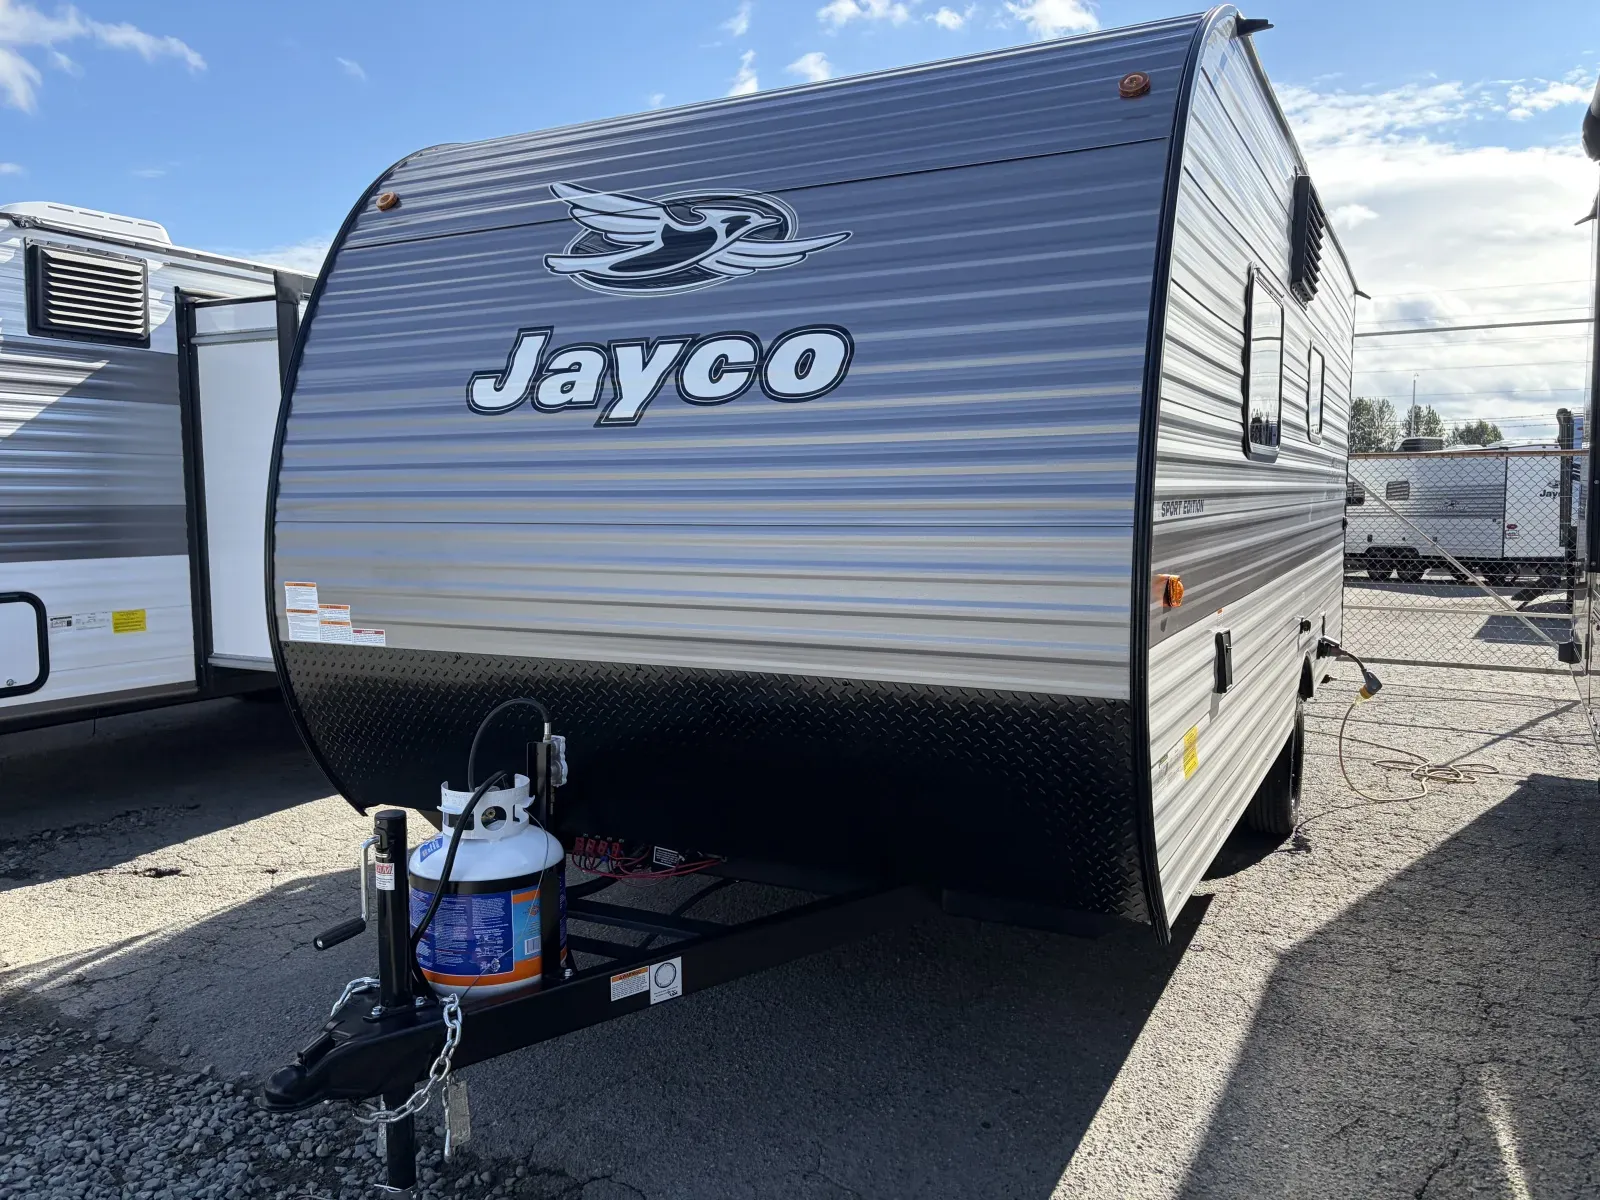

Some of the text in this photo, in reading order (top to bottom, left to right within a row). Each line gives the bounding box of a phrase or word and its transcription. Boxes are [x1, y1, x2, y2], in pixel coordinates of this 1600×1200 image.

[466, 325, 855, 428] Jayco
[1540, 489, 1561, 500] Jay
[1161, 499, 1205, 517] SPORT EDITION
